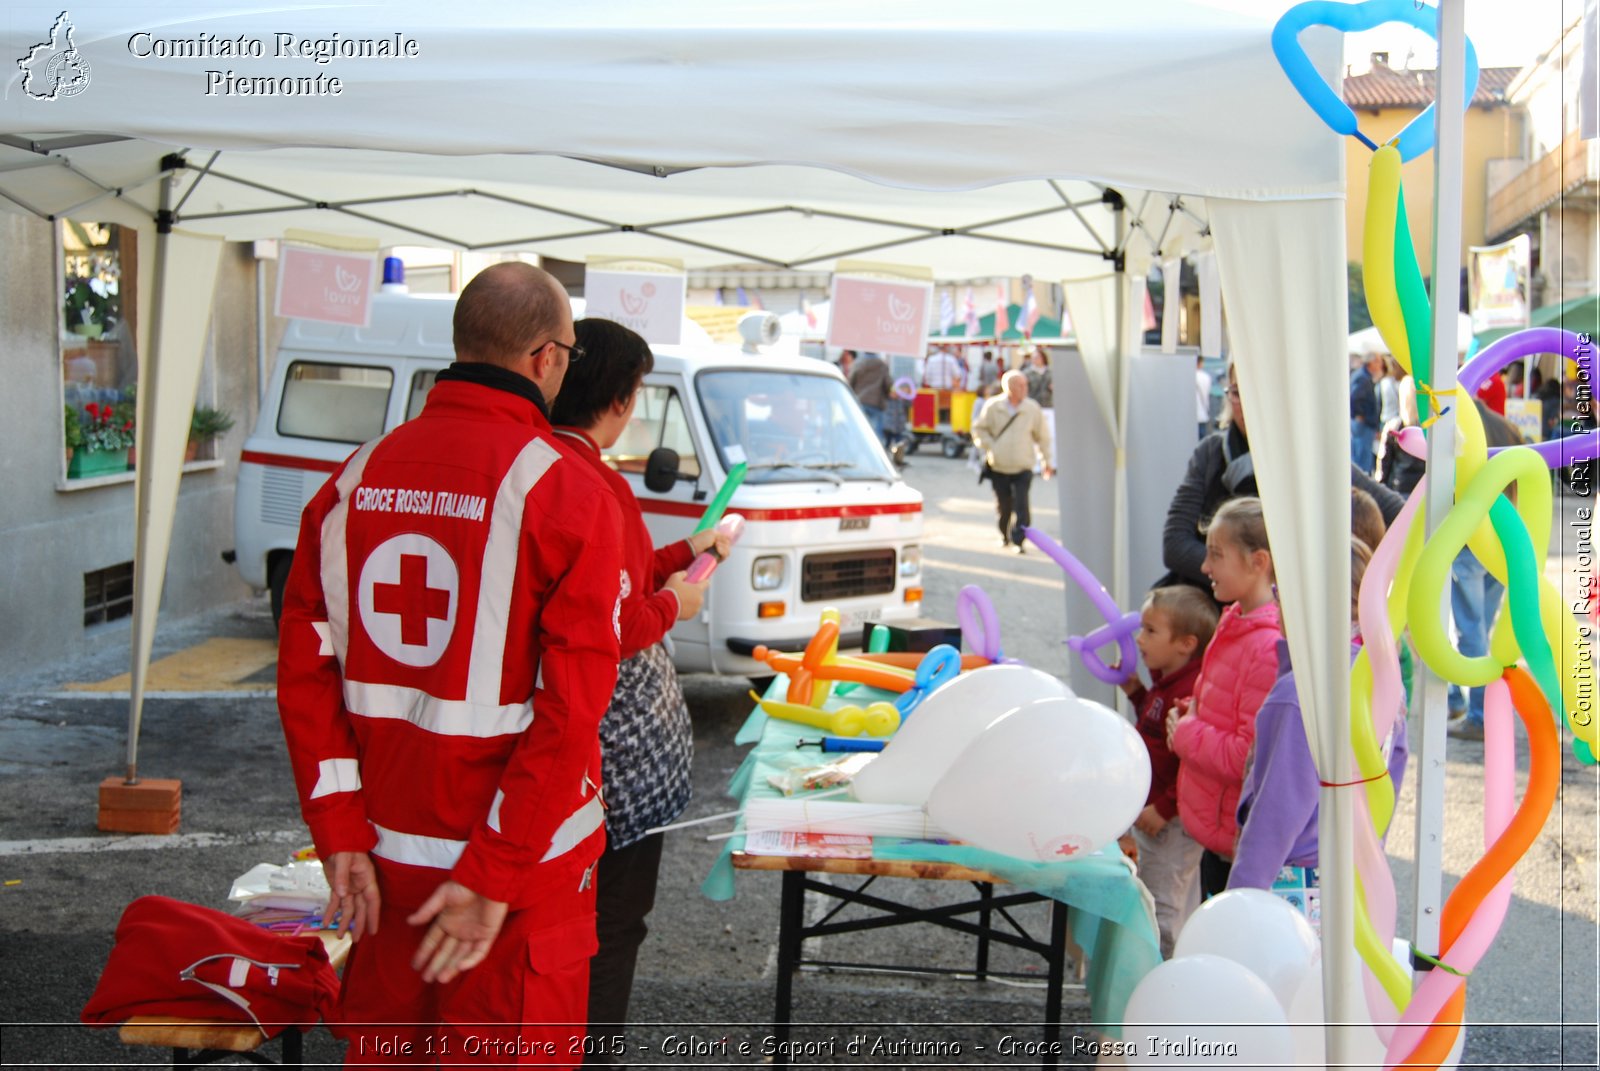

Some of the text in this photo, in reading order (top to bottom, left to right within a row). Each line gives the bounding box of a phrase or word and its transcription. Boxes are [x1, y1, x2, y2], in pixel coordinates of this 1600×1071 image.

[356, 486, 487, 522] CROCE ROSSA ITALIANA
